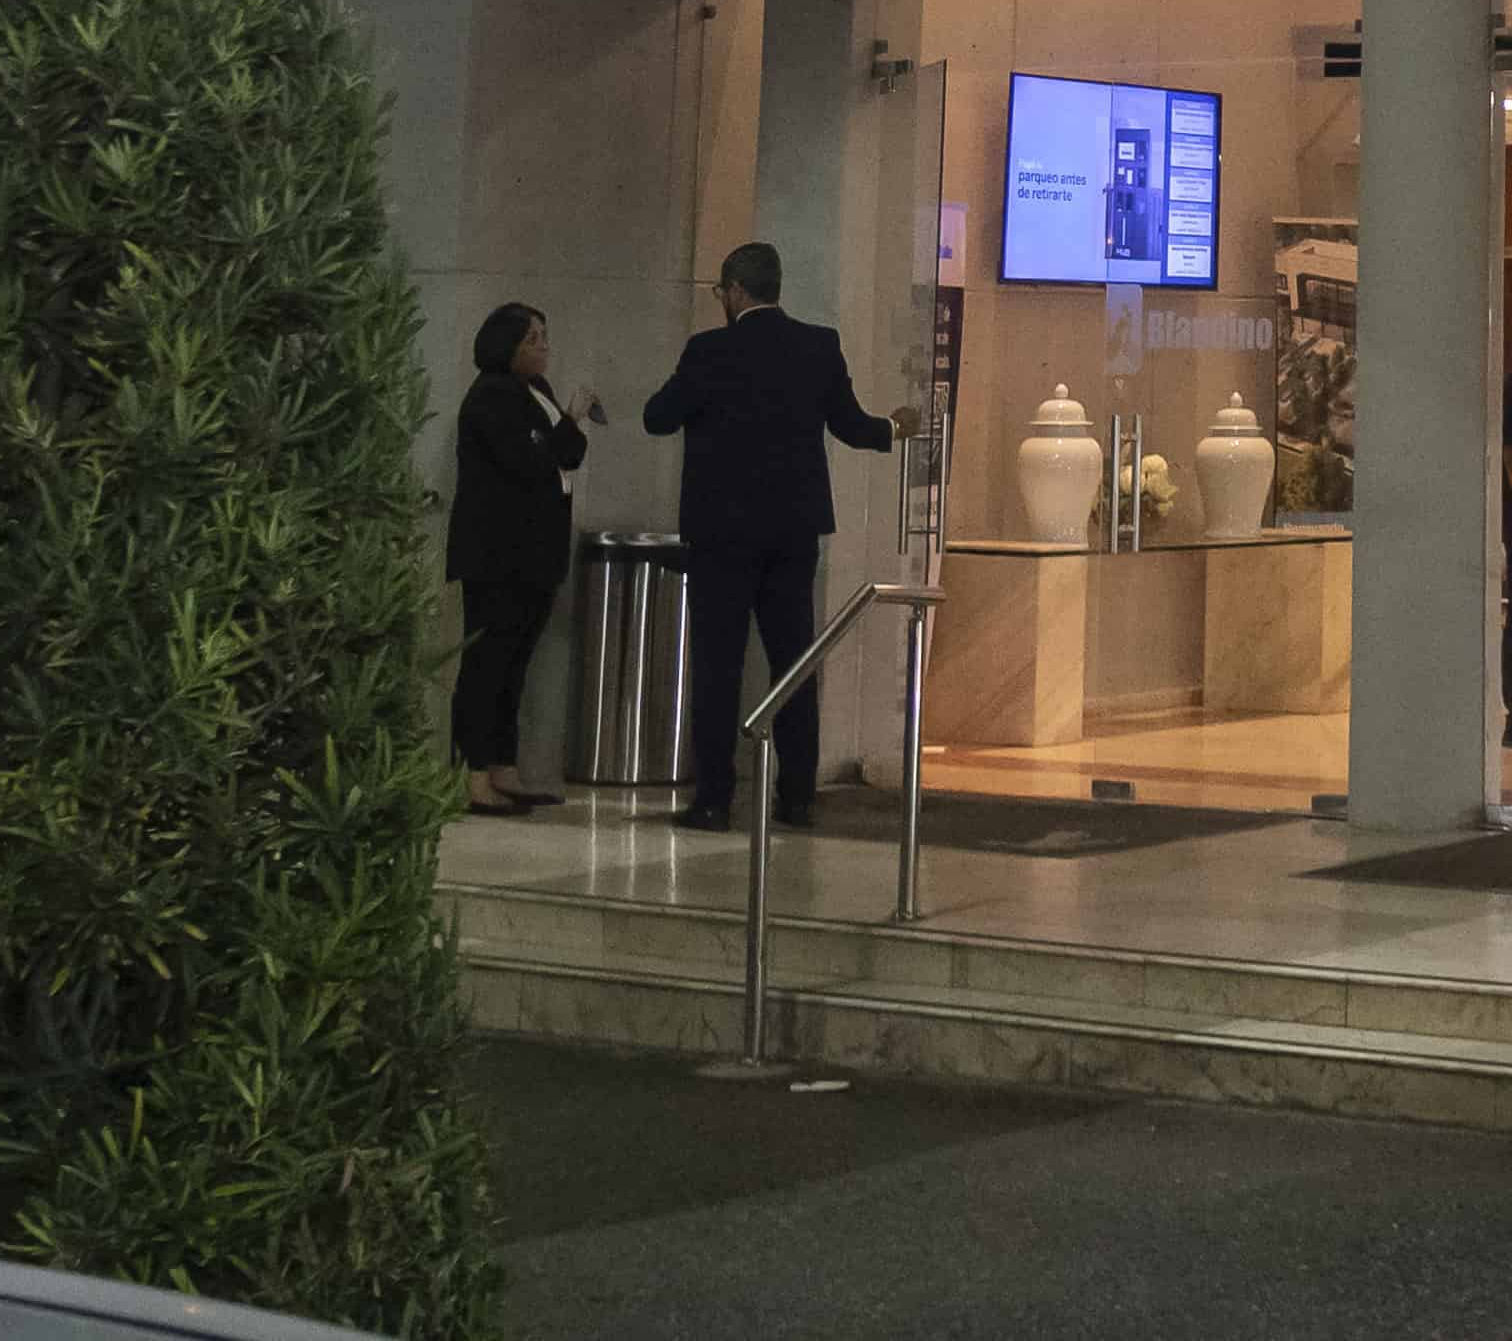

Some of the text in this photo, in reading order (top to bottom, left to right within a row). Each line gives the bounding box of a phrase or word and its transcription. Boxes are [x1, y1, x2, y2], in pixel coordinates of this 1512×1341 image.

[1018, 170, 1087, 186] parqueo antes
[1018, 188, 1073, 202] de retirarte
